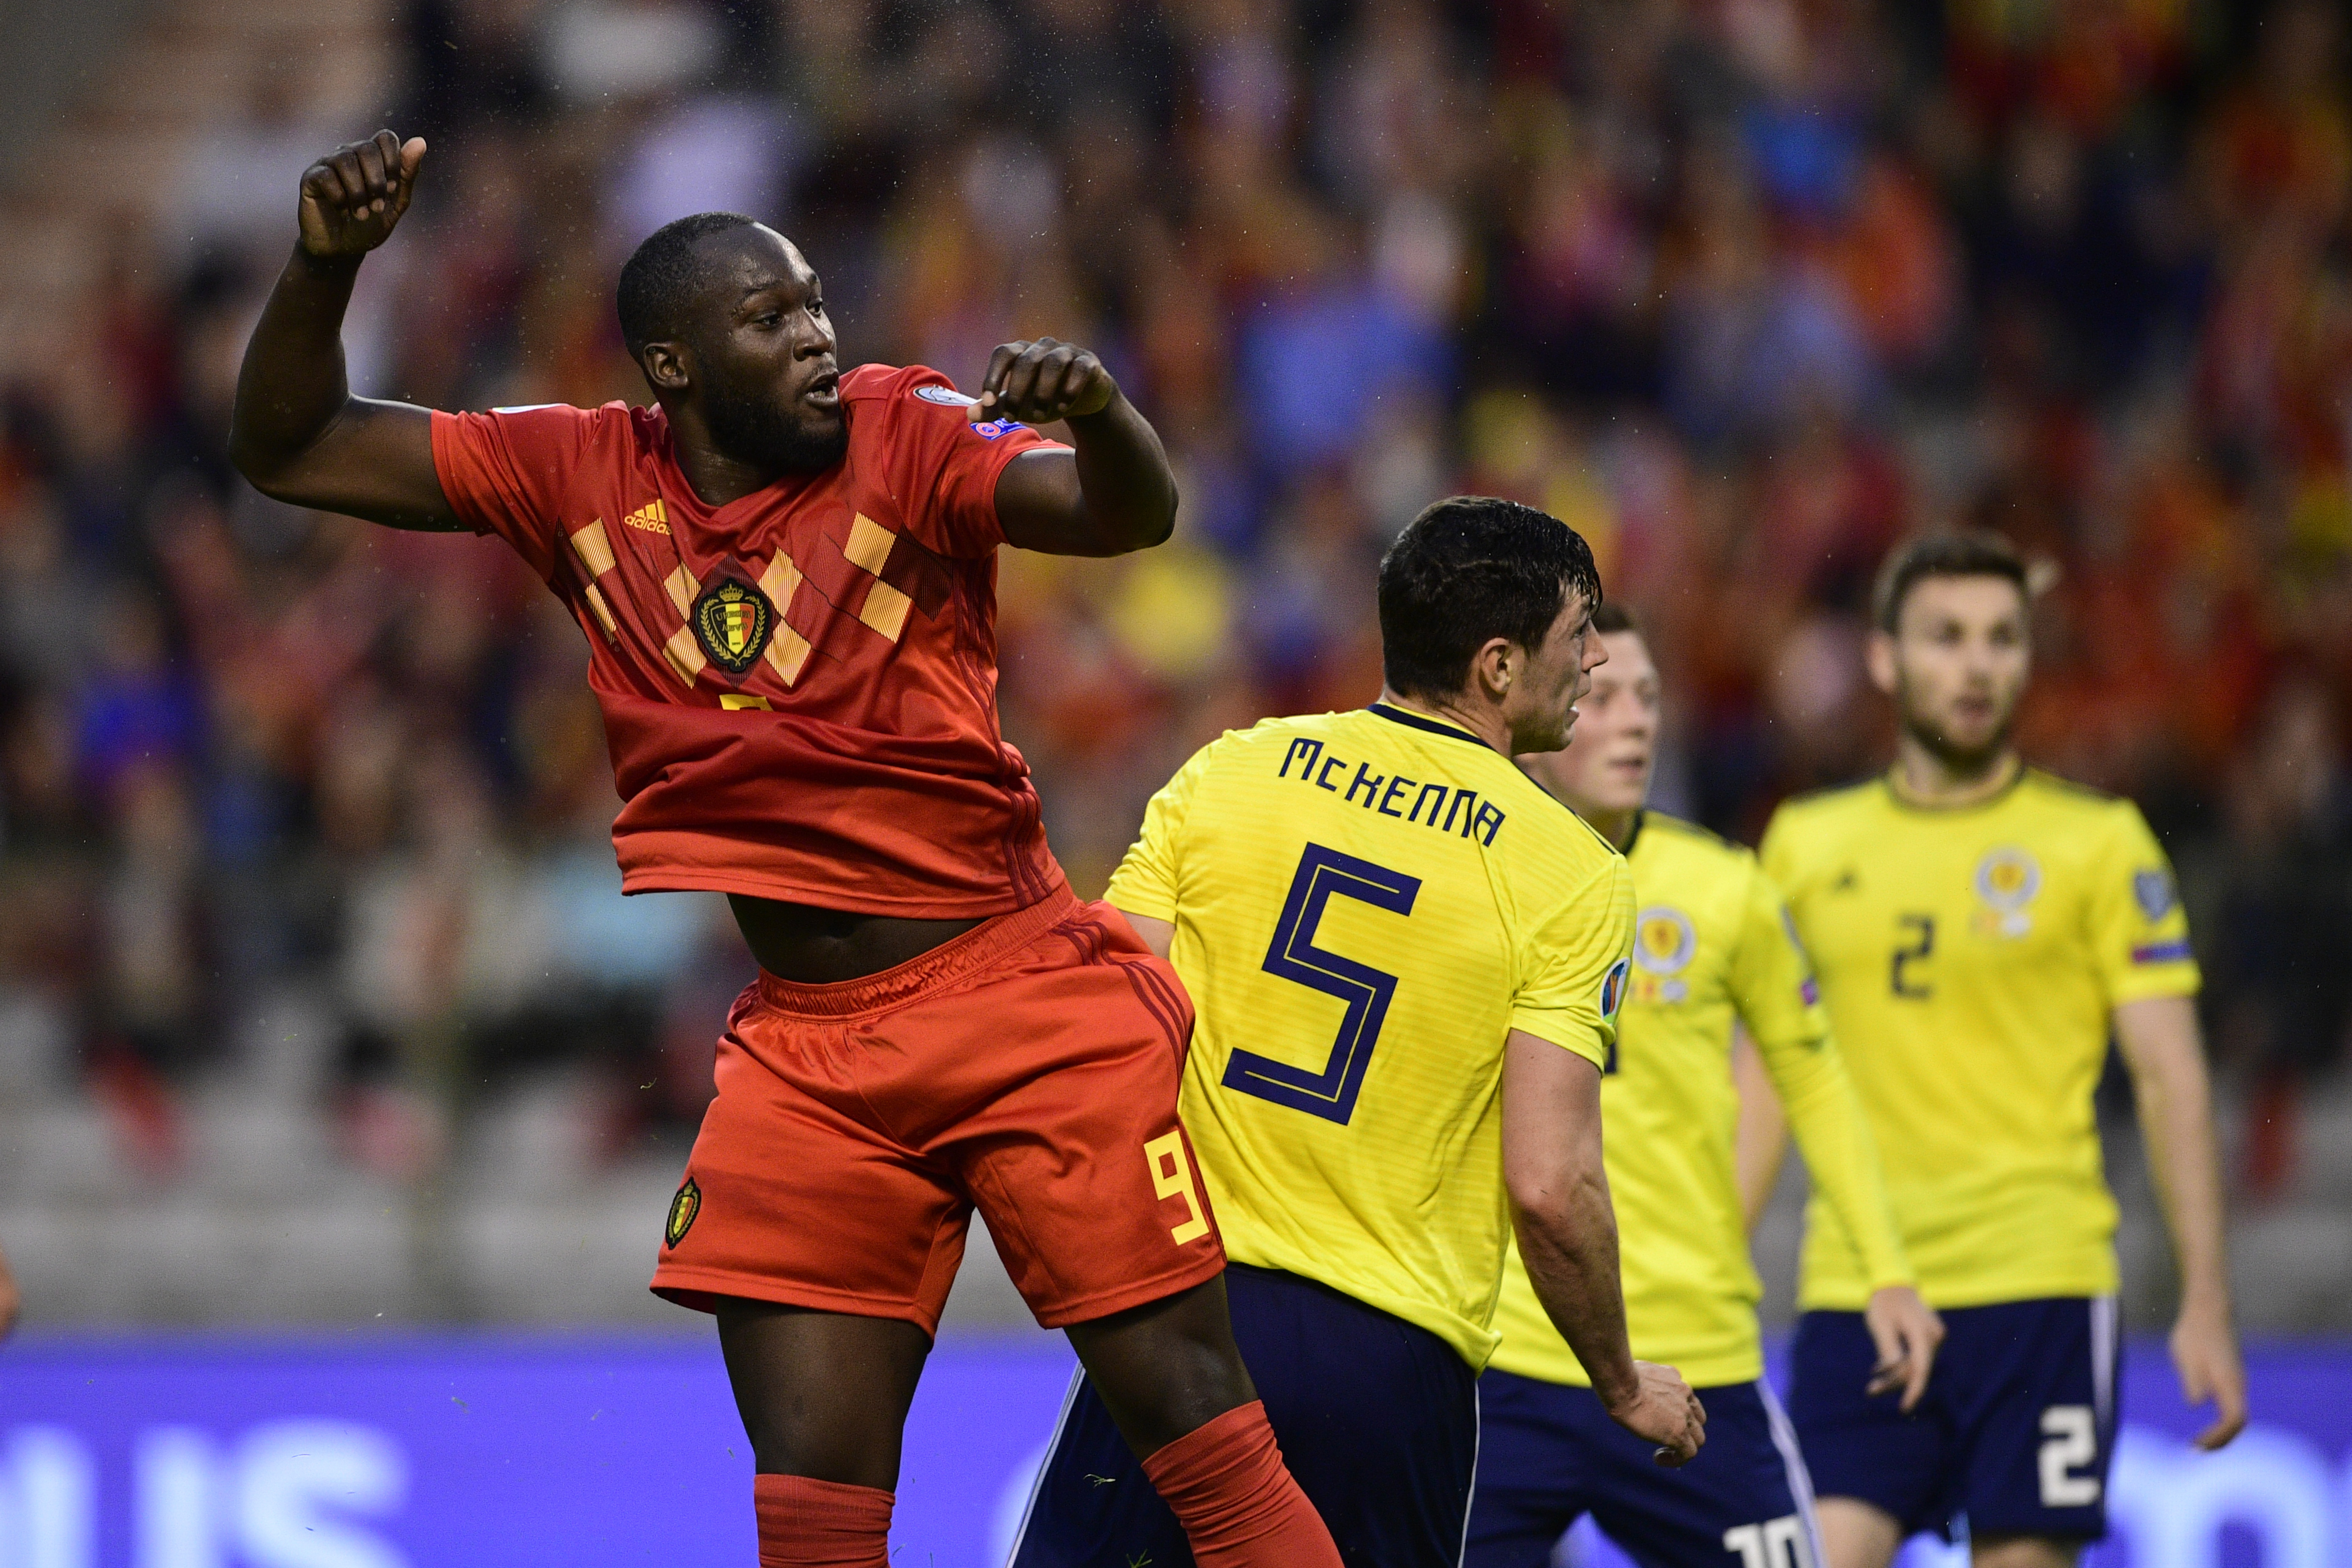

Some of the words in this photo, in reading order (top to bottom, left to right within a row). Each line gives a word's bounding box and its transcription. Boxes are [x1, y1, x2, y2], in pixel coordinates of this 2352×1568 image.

[1220, 841, 1423, 1126] 5
[1890, 911, 1935, 1000] 2
[1143, 1130, 1210, 1246] 9
[2037, 1405, 2102, 1508] 2
